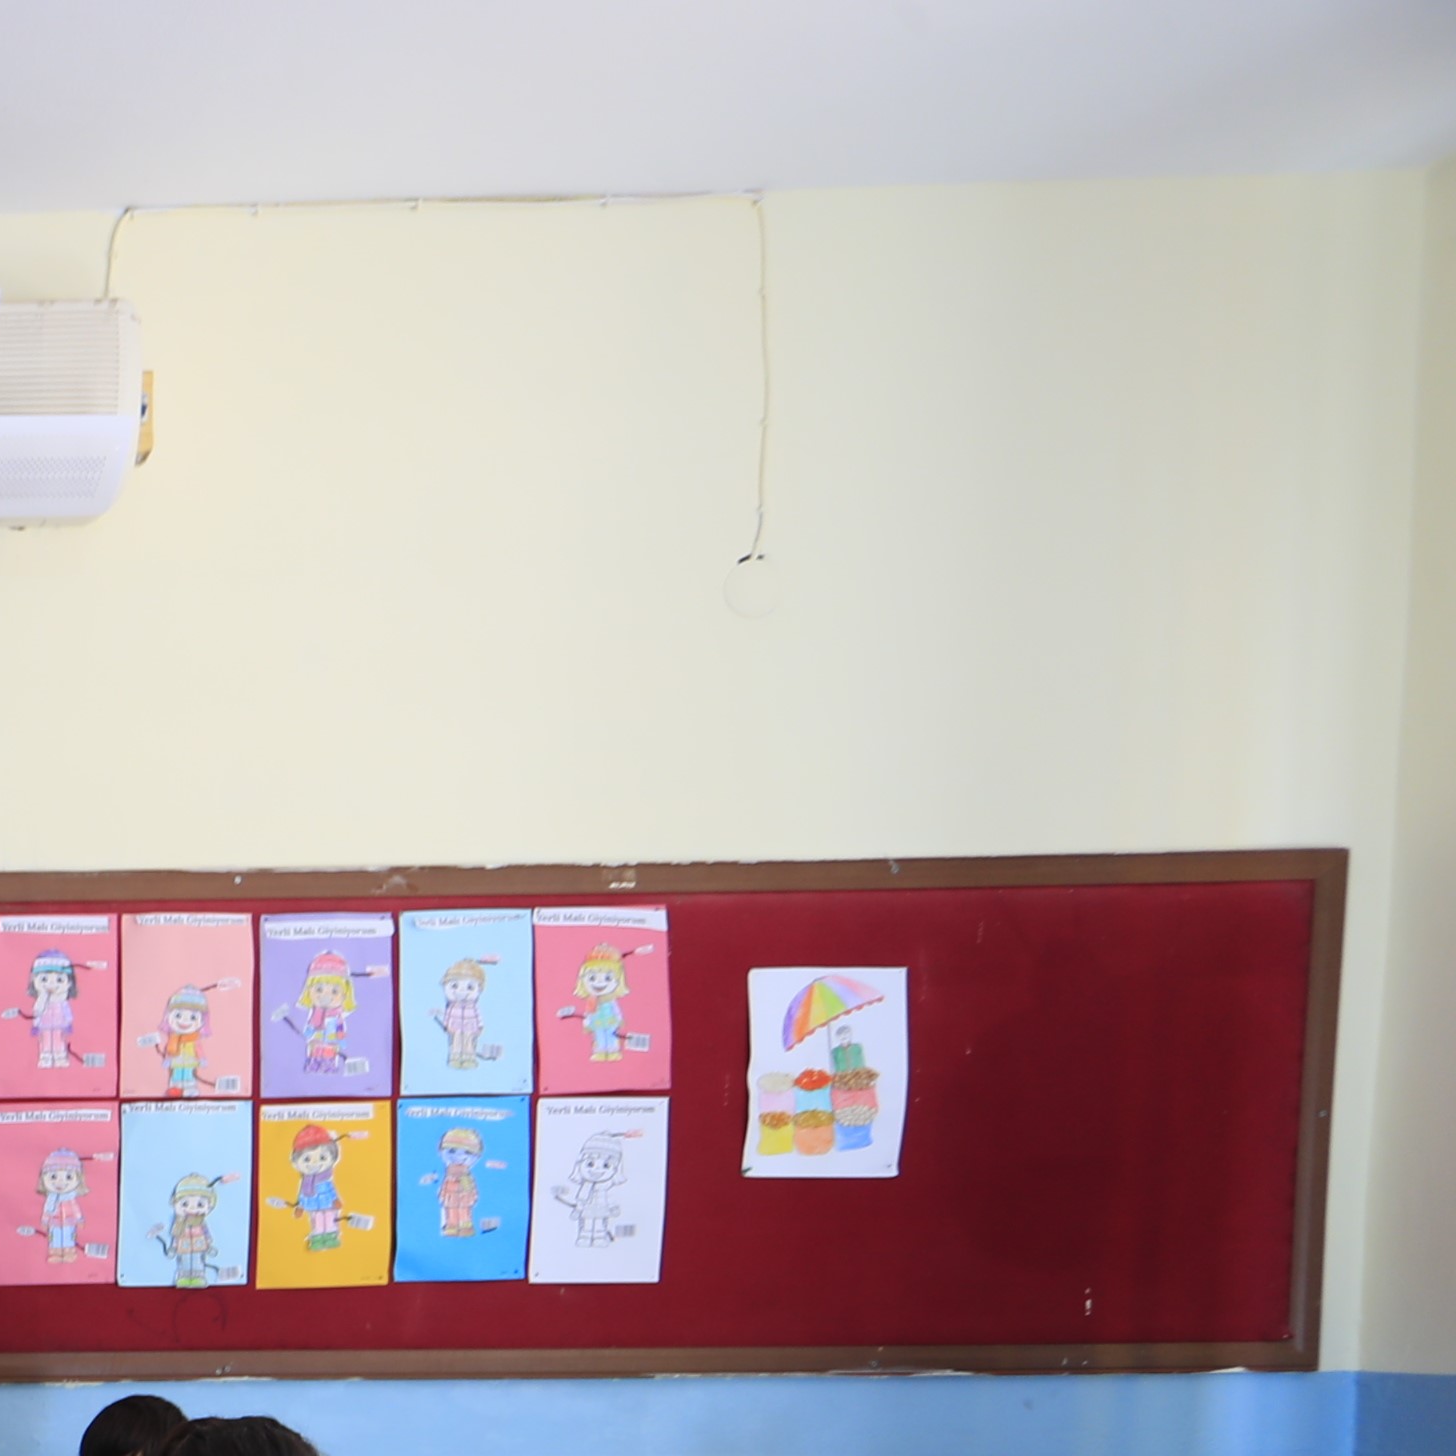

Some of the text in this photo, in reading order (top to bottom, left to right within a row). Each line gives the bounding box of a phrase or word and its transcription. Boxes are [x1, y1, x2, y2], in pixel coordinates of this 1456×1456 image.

[546, 1105, 655, 1116] Yerli Malı Giyiniyorum
